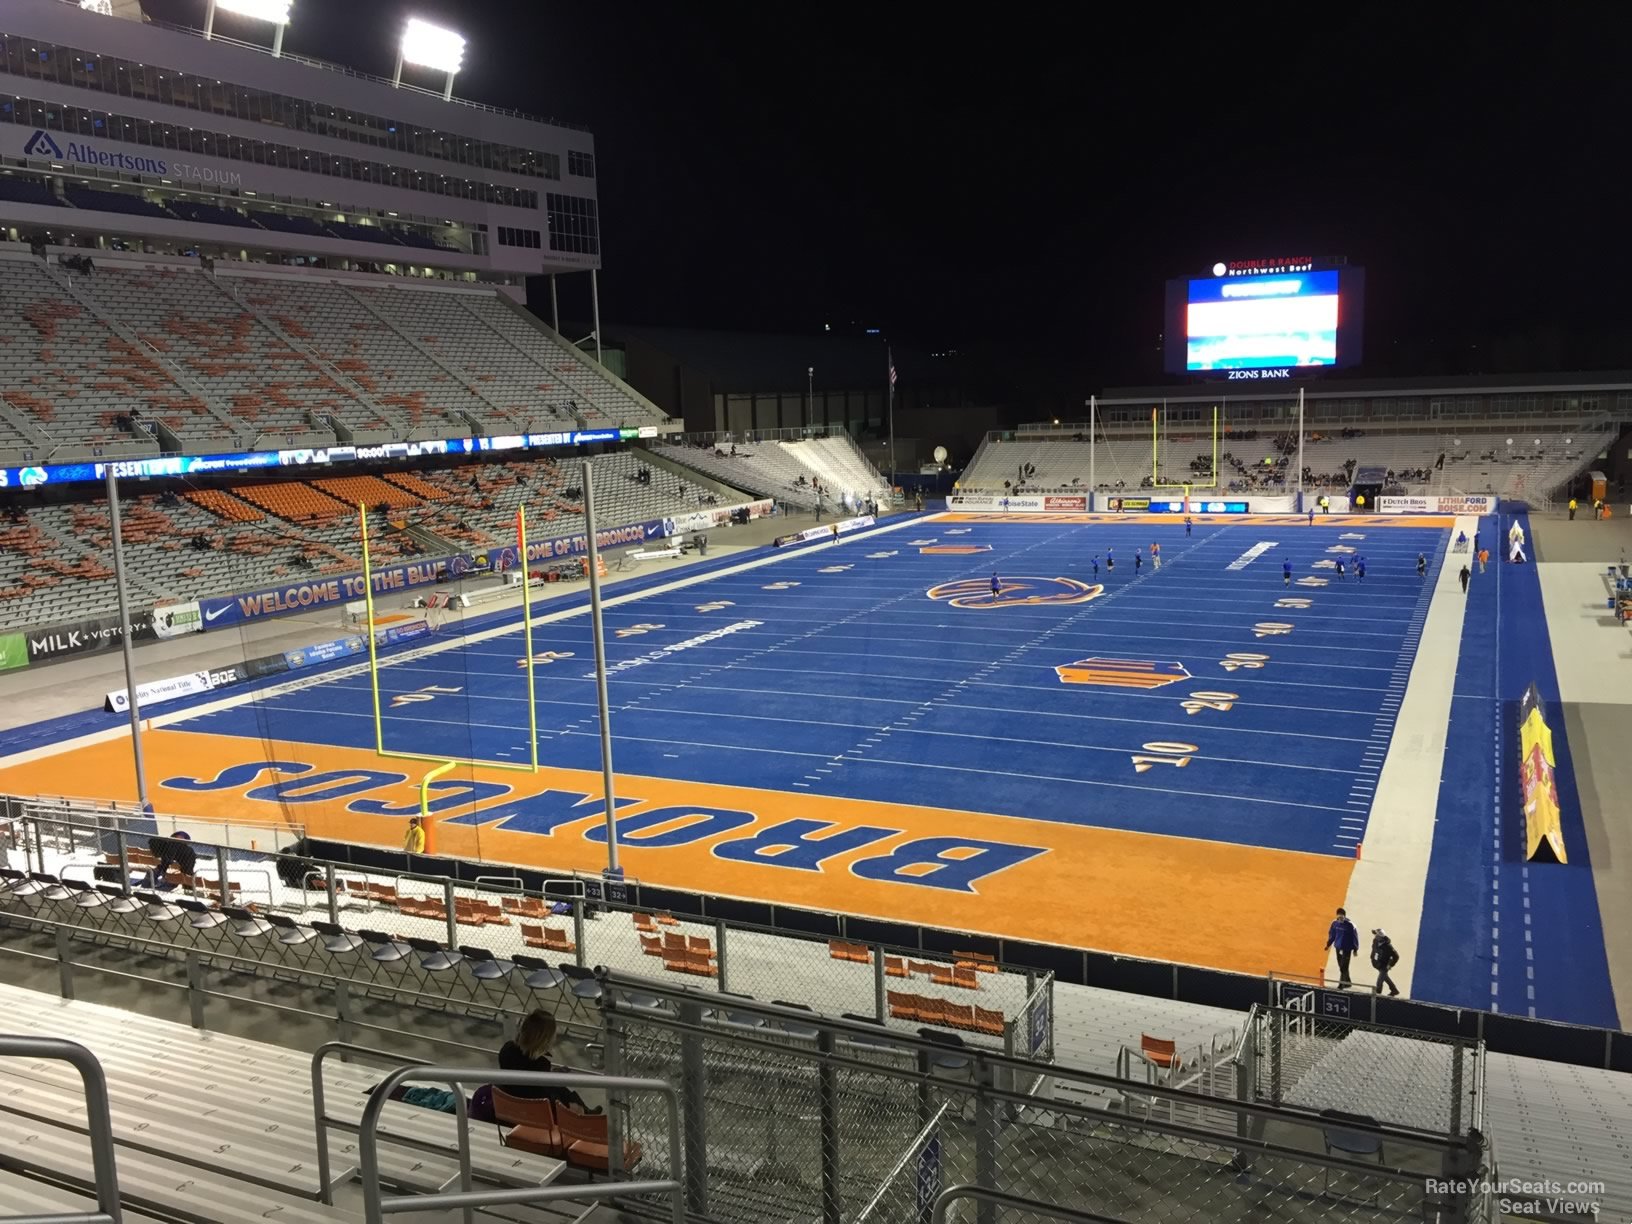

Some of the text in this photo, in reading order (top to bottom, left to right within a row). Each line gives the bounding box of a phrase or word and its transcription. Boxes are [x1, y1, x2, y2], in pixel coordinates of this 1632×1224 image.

[67, 142, 242, 184] Albertsons STADIUM
[1228, 263, 1312, 276] Northwest Beef
[1229, 258, 1267, 269] DOUBLE
[1278, 256, 1312, 267] RANCH
[1228, 369, 1290, 379] ZIONS BANK
[1438, 504, 1487, 512] BOISE.COM
[555, 538, 571, 555] OF
[573, 535, 588, 552] TH
[597, 525, 645, 547] BRONCOS
[239, 562, 446, 617] WELCOME TO THE BLUE
[31, 630, 82, 655] MILK
[151, 683, 177, 695] National
[178, 680, 191, 689] Title
[1180, 691, 1239, 712] 20
[1131, 742, 1199, 768] 10
[159, 760, 1053, 894] BRONCOS
[1326, 1002, 1340, 1012] 31
